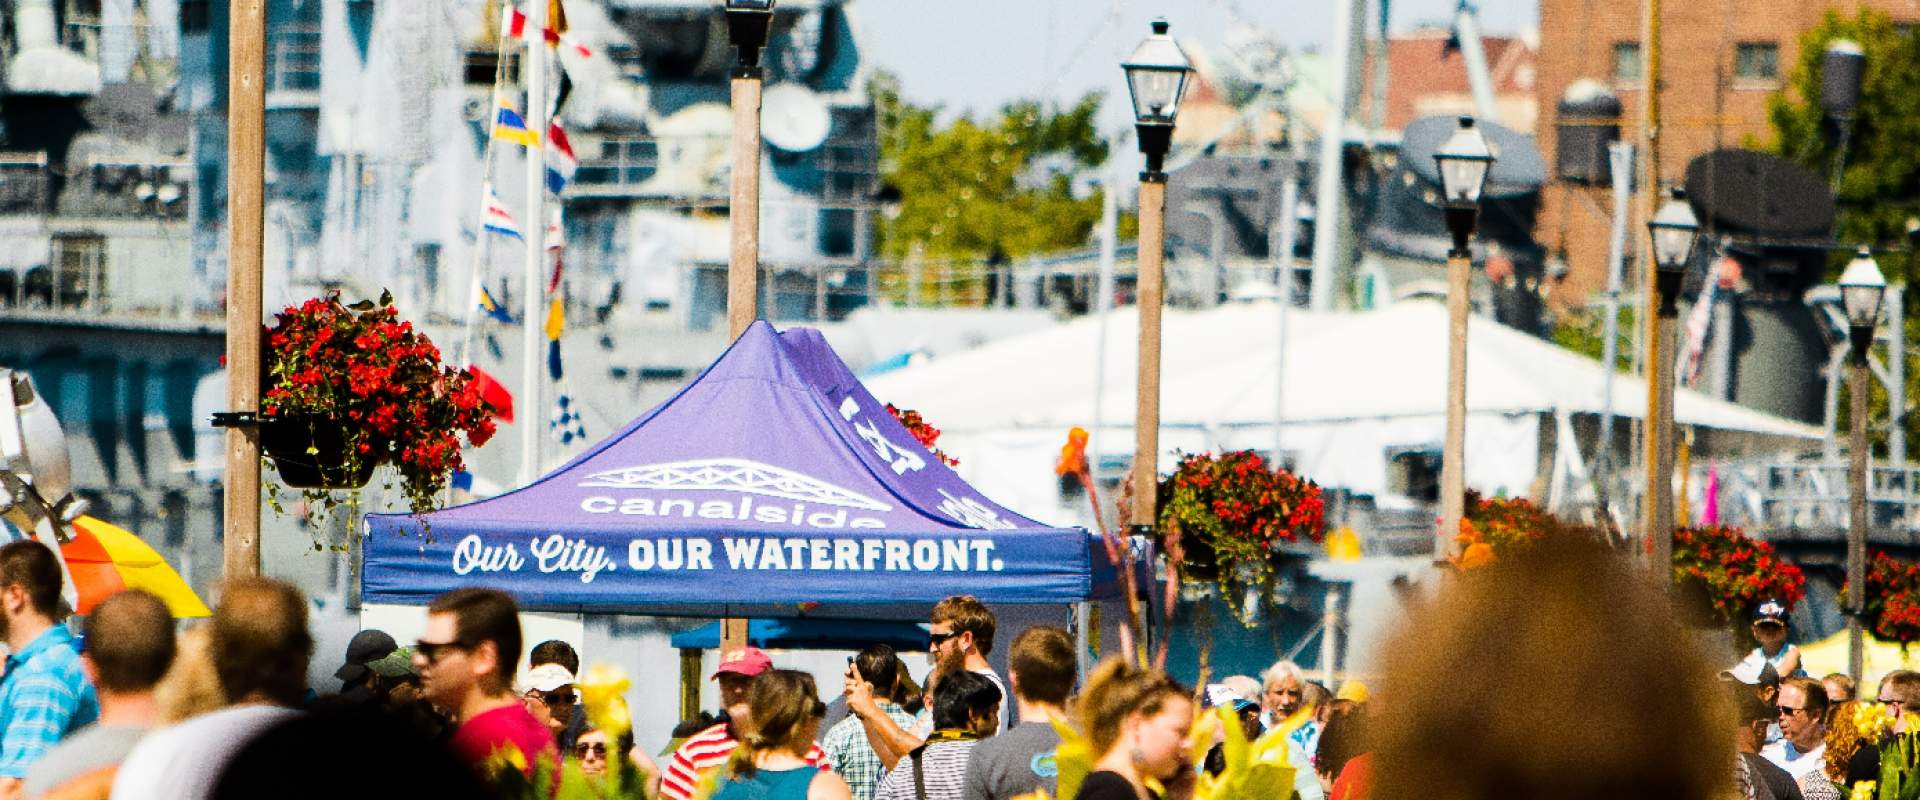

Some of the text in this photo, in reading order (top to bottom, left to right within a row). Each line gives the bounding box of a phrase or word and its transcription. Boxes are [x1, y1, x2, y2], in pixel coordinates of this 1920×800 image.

[580, 495, 886, 530] canalside
[452, 533, 1004, 584] Our City. OUR WATERFRONT.
